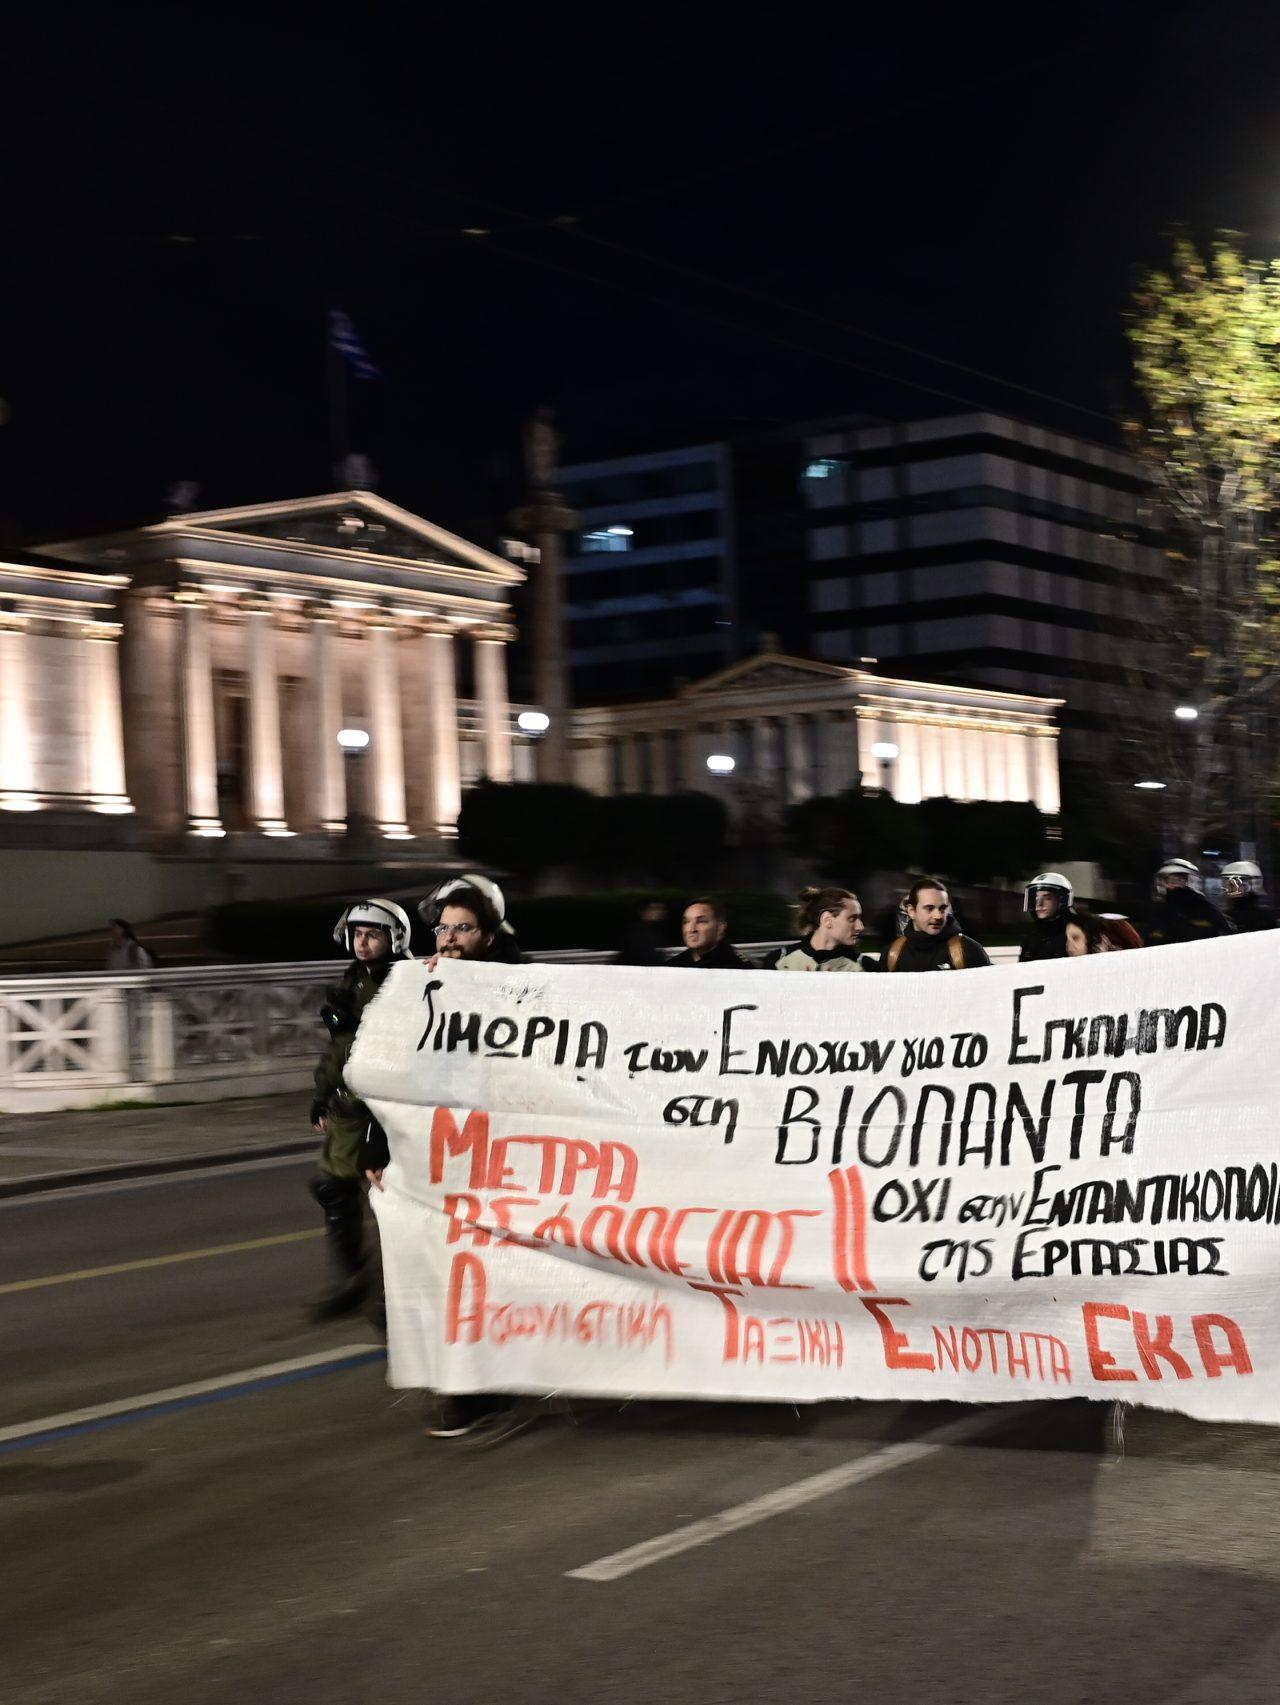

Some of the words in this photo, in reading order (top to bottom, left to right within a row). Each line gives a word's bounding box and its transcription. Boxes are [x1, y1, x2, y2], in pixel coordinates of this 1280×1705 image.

[623, 1040, 709, 1074] των
[951, 1032, 988, 1069] το
[662, 1094, 740, 1144] στη
[430, 1106, 640, 1203] ΜΕΤΡΑ
[873, 1176, 952, 1223] ΟΧΙ
[918, 1237, 996, 1283] της
[1081, 1301, 1254, 1382] ΕΚΑ
